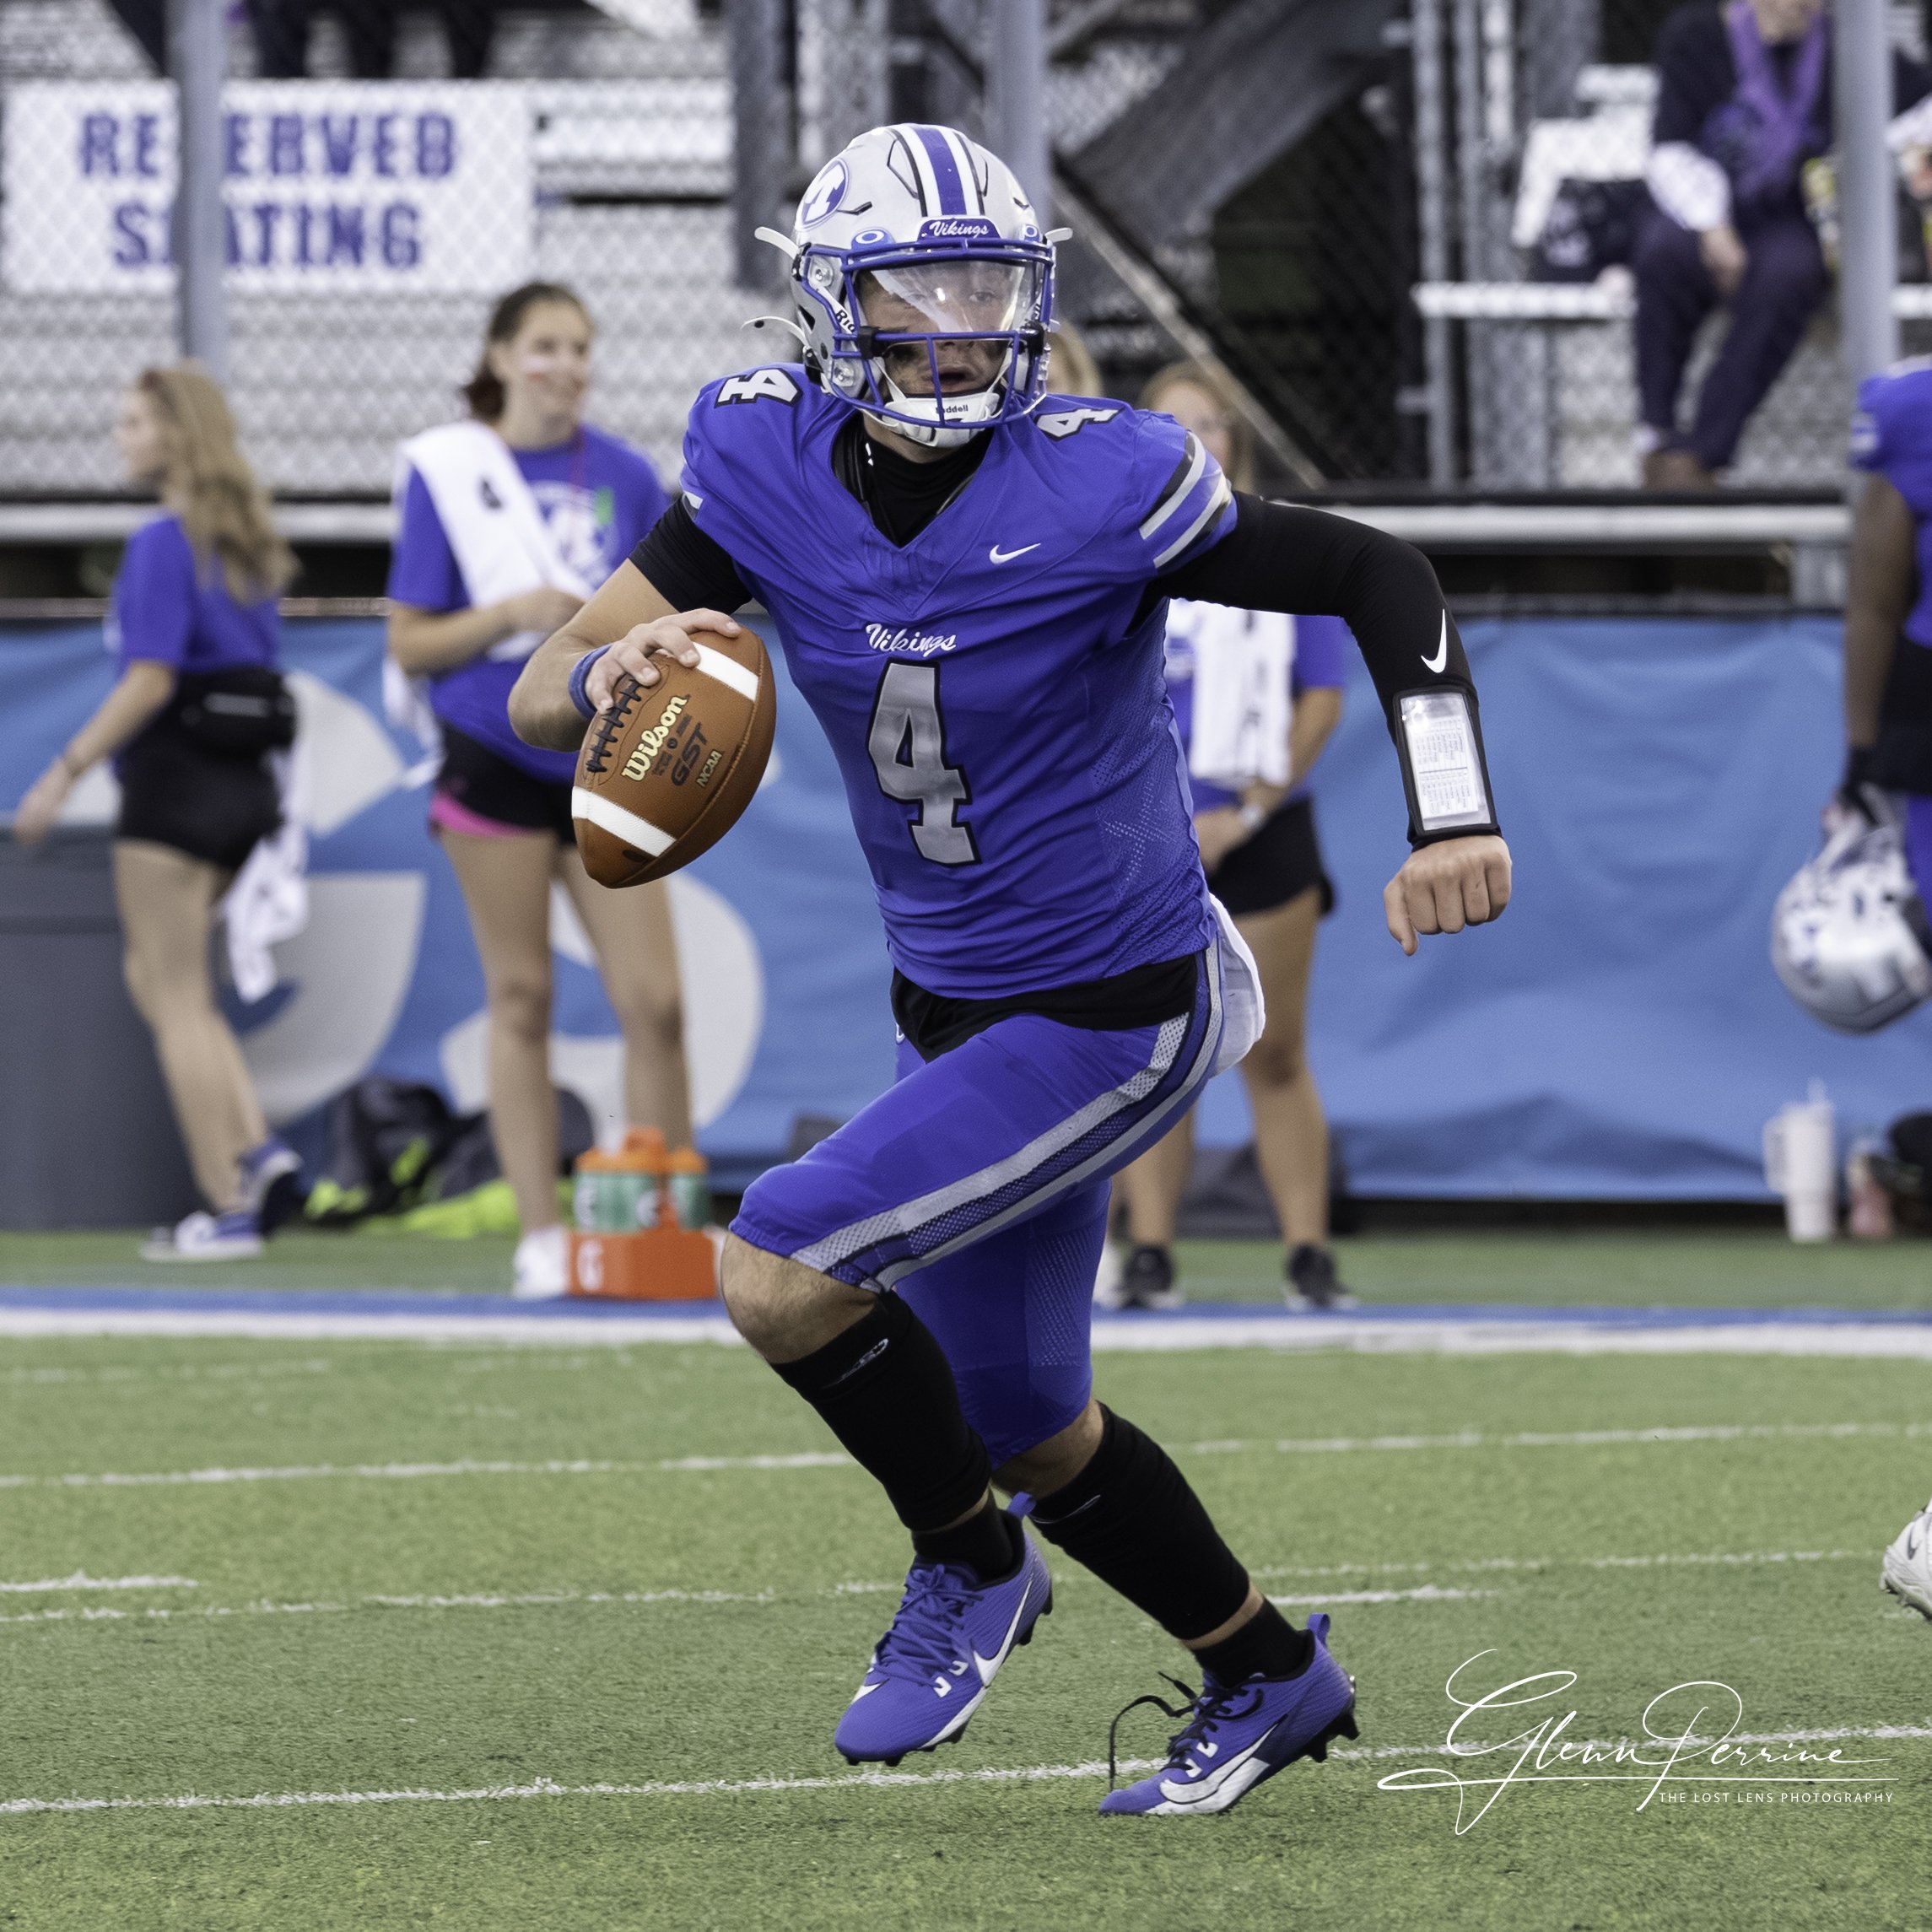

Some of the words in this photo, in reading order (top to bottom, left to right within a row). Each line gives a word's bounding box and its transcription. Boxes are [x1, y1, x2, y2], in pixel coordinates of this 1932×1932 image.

[80, 112, 455, 179] REERVED
[113, 202, 422, 268] STING
[929, 220, 990, 238] Vikings
[715, 366, 801, 410] 4
[935, 404, 969, 415] ddell
[1036, 406, 1124, 441] 4
[866, 623, 956, 657] Vikings
[621, 695, 689, 781] Wilson
[671, 721, 707, 786] GST
[696, 749, 723, 788] NCAA
[866, 657, 982, 865] 4
